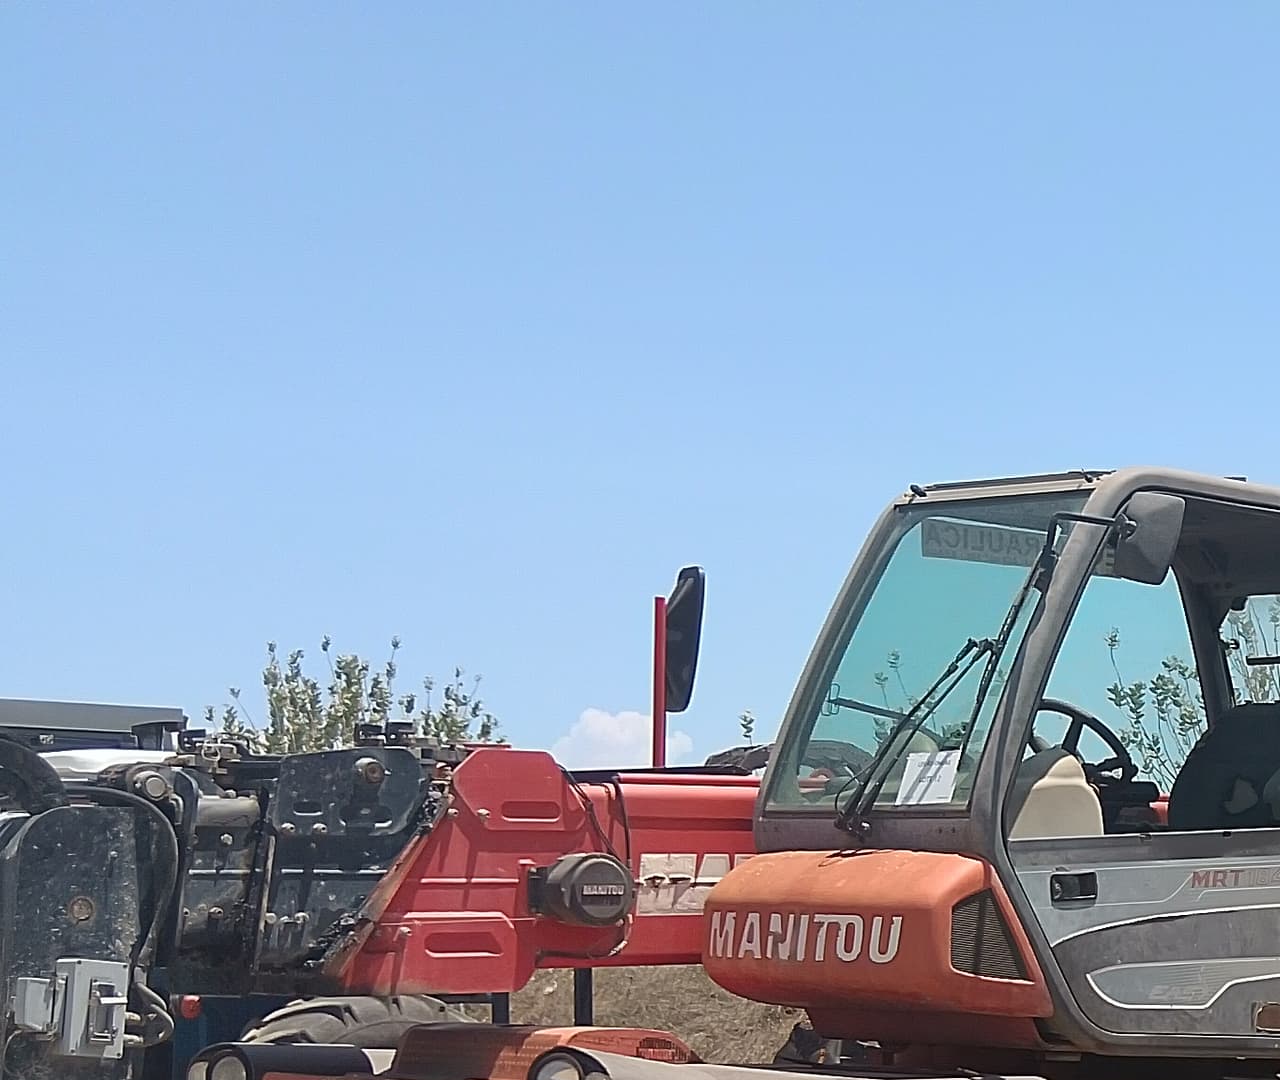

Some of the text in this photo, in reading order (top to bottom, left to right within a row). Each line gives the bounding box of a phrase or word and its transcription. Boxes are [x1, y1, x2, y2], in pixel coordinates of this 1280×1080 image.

[1192, 869, 1244, 889] MRT
[583, 884, 625, 895] MANITOU
[709, 911, 903, 963] MANITOU
